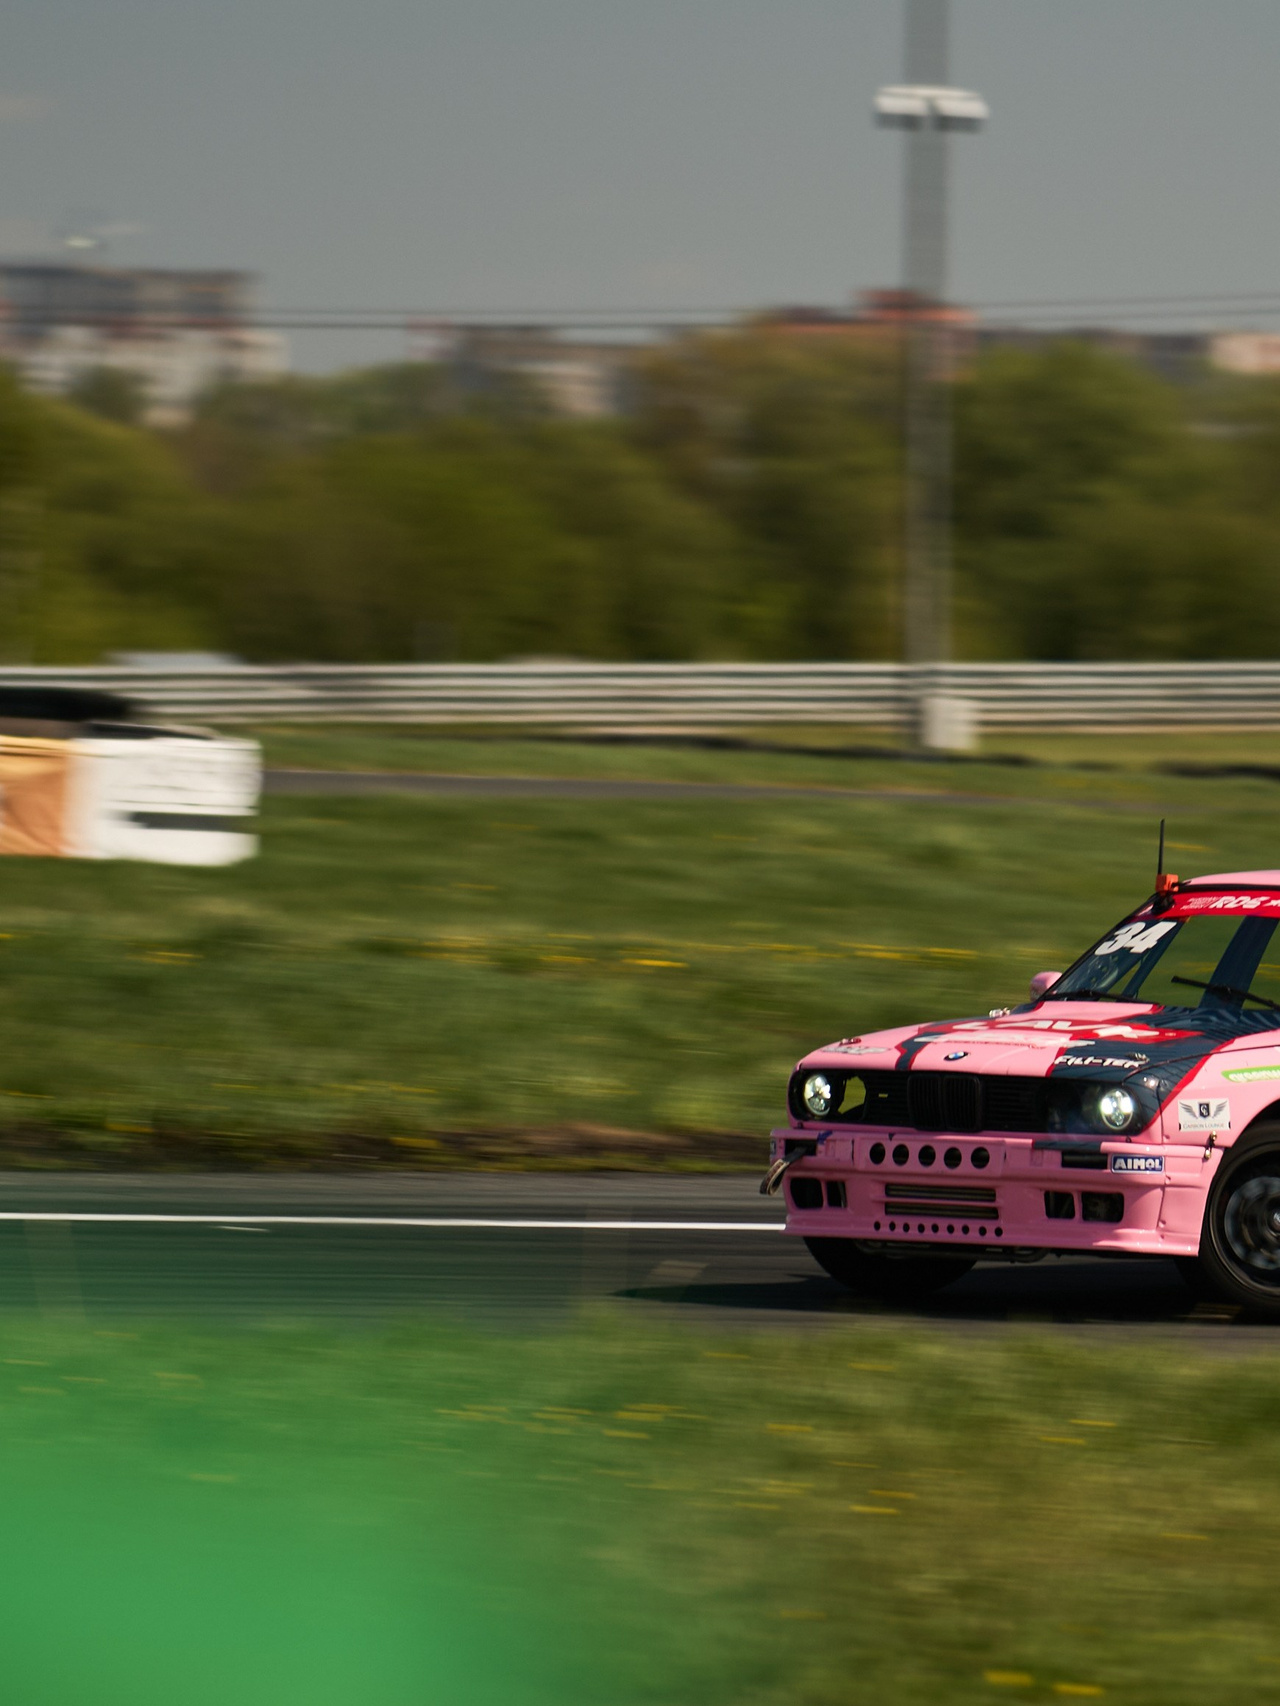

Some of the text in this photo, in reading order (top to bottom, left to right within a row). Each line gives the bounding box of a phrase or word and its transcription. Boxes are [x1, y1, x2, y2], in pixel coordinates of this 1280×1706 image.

[1208, 895, 1270, 909] RDS
[1094, 921, 1177, 955] 34
[1114, 1158, 1162, 1169] AIMOL
